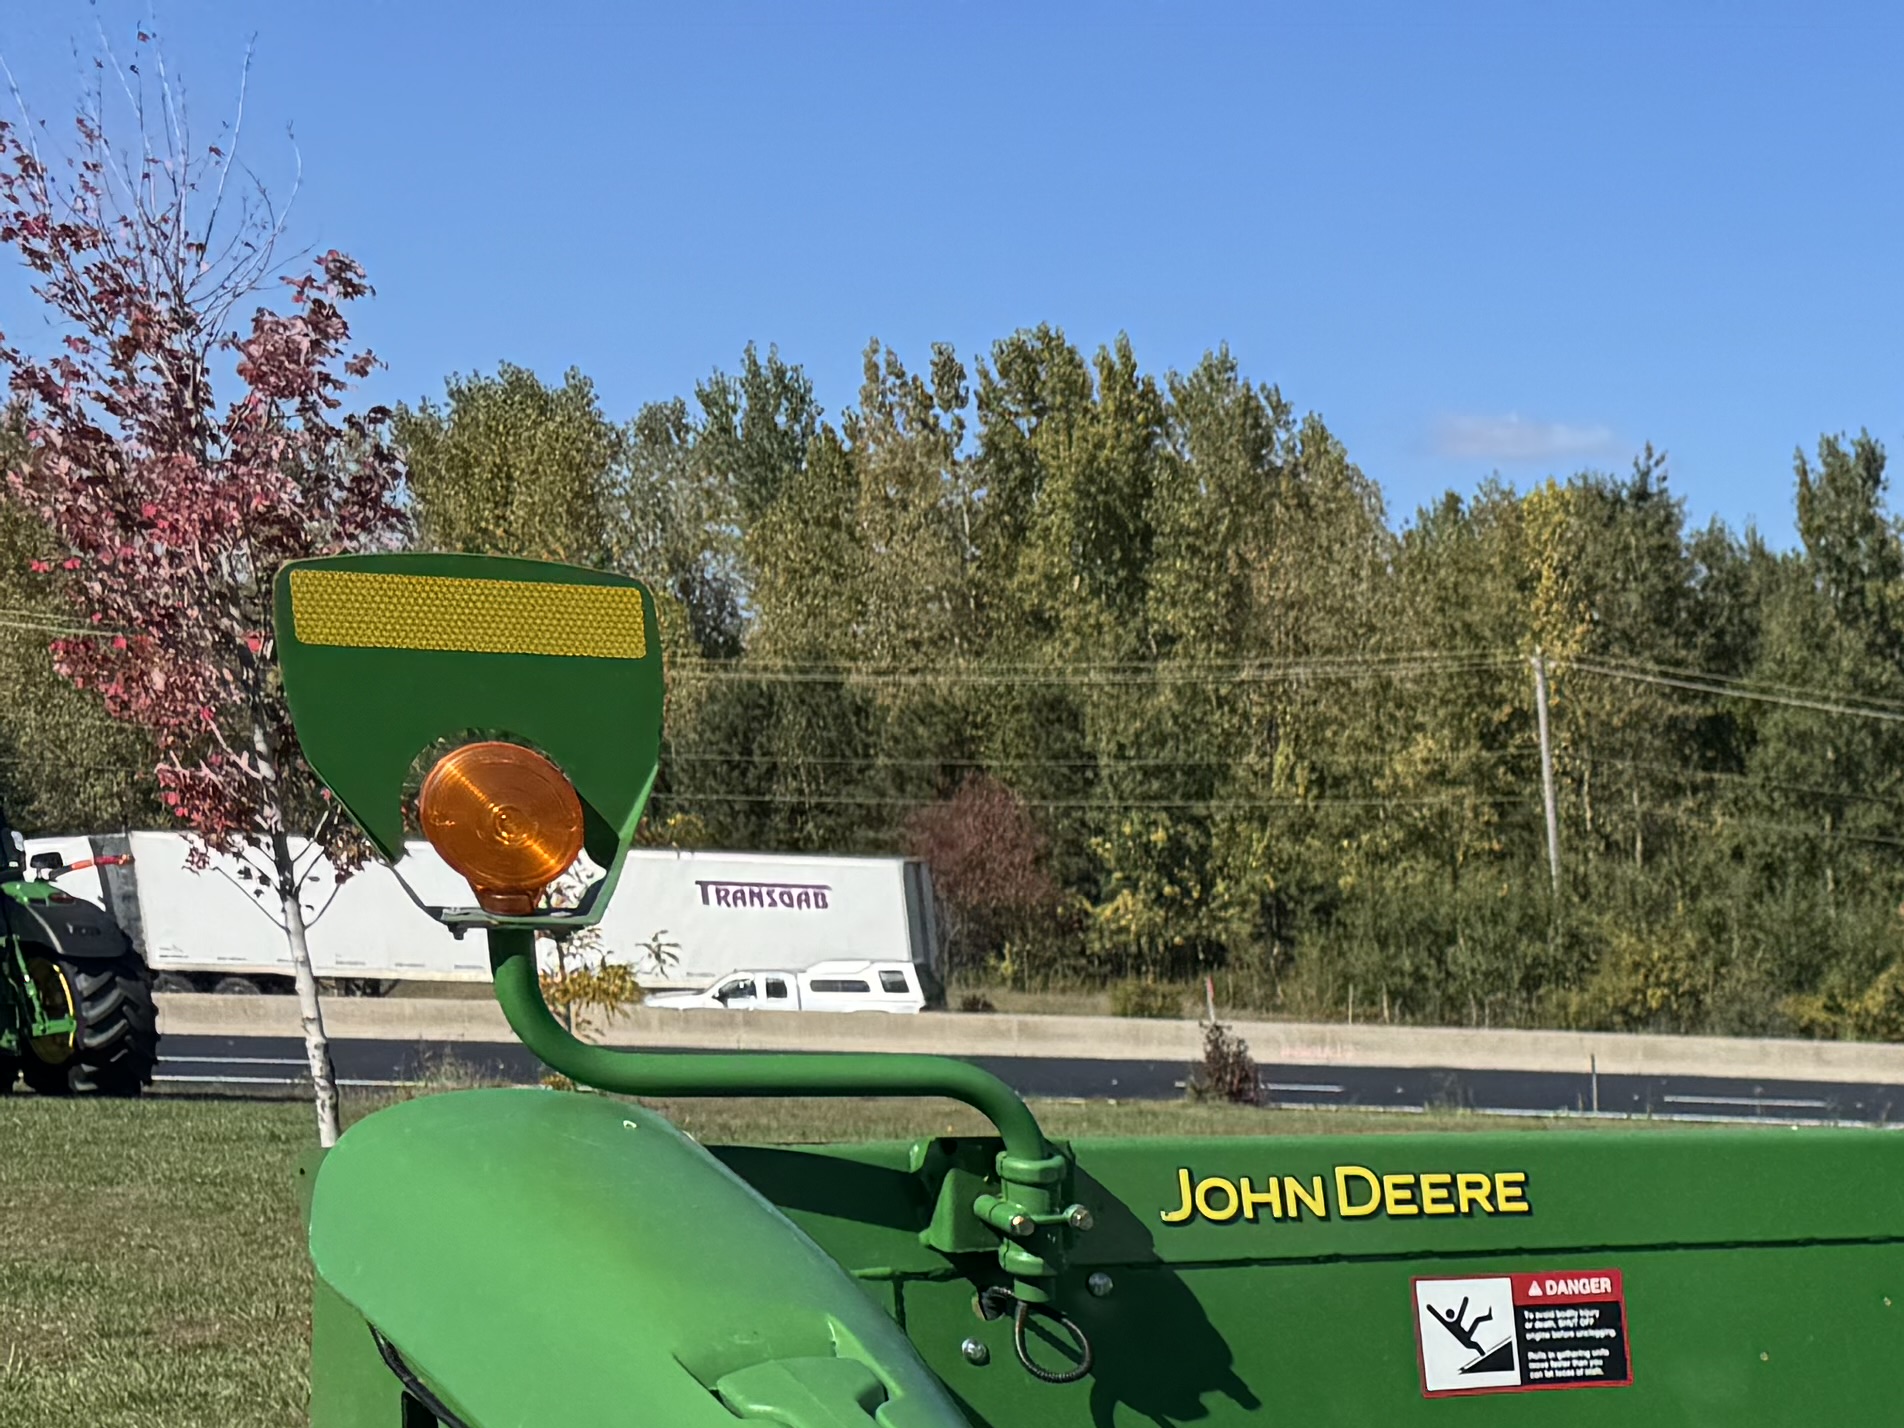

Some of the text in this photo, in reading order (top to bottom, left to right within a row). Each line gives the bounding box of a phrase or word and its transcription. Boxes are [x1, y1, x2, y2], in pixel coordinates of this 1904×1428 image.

[1160, 1165, 1529, 1222] JOHN DEERE
[1545, 1277, 1612, 1296] DANGER
